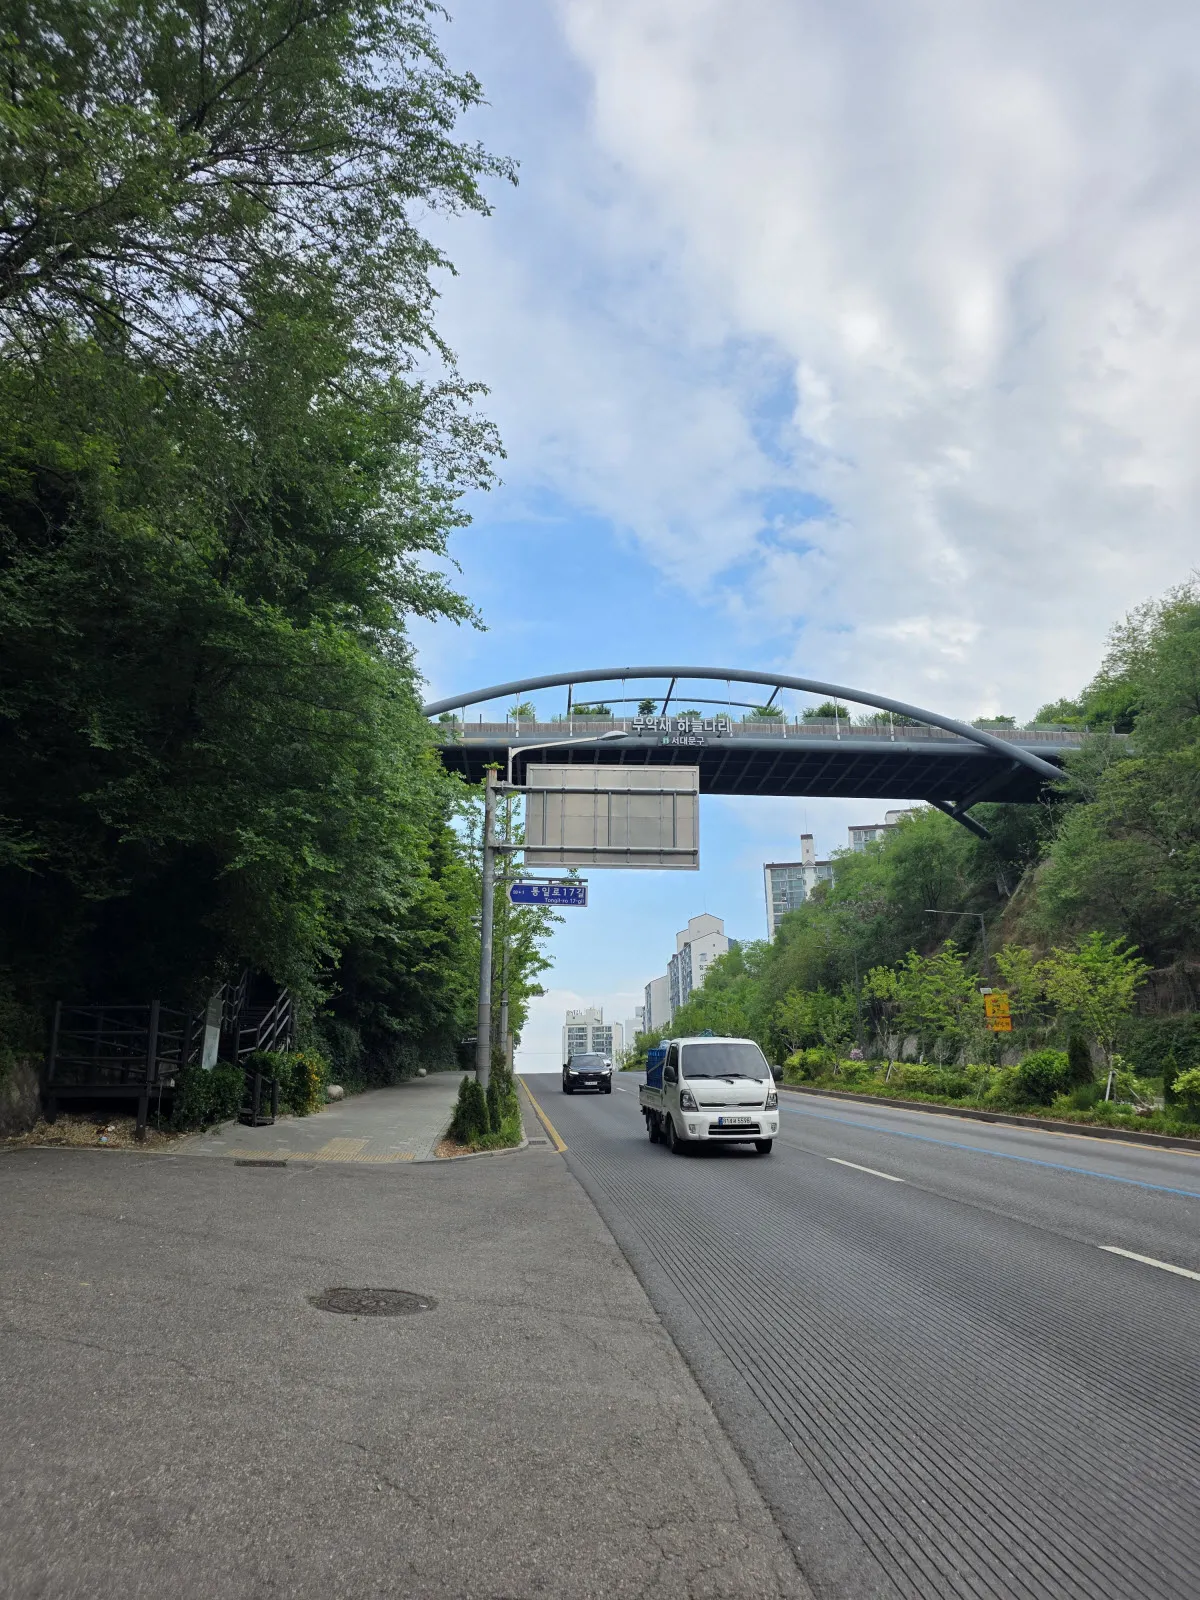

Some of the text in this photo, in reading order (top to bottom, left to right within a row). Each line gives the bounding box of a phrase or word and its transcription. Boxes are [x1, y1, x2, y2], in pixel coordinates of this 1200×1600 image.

[632, 717, 731, 732] 무악재 하늘다리
[671, 737, 705, 746] 서대문구
[531, 886, 585, 898] 통일로17길
